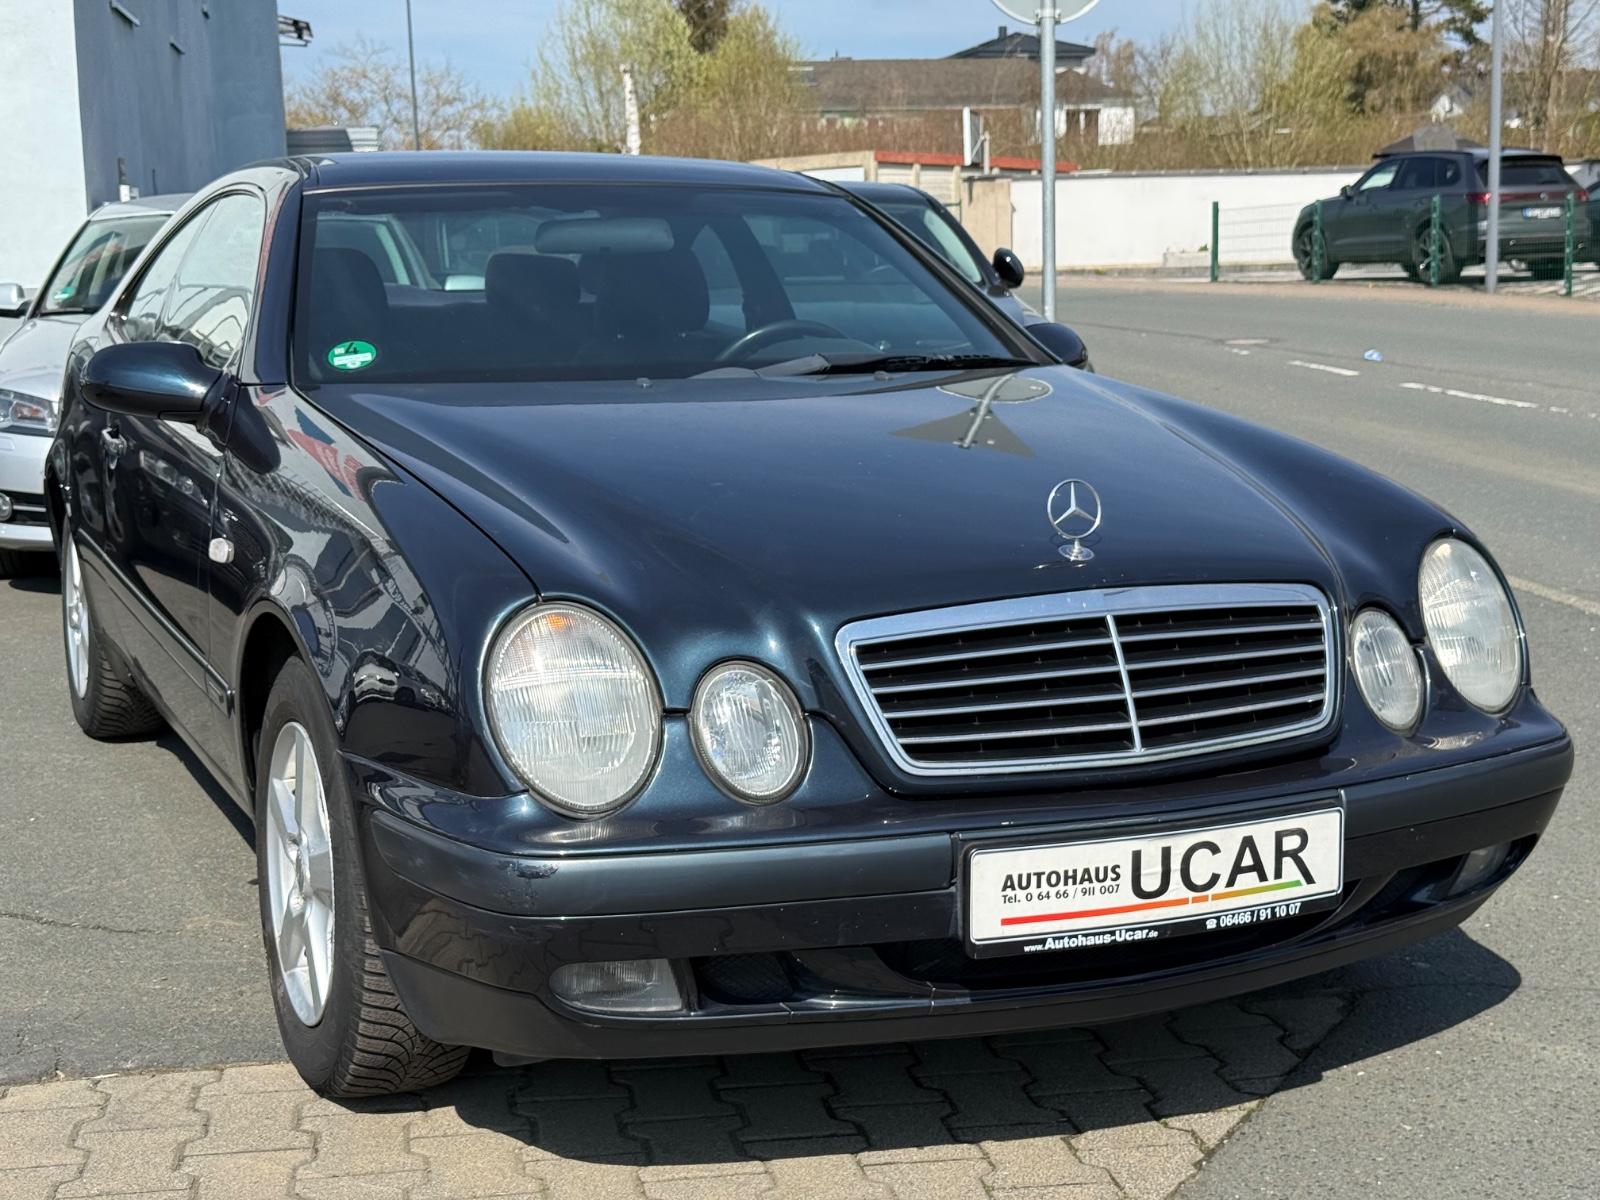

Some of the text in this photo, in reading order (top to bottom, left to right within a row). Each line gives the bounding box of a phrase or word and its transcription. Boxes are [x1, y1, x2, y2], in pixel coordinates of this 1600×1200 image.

[1001, 827, 1317, 900] AUTOHAUS UCAR
[1002, 884, 1120, 904] Tel. 0 64 66 / 911 007
[1219, 912, 1252, 928] 06466
[1259, 908, 1274, 920] 91
[1275, 906, 1287, 919] 10
[1288, 903, 1301, 917] 07
[1023, 928, 1159, 953] www.Autohaus-Ucar.de
